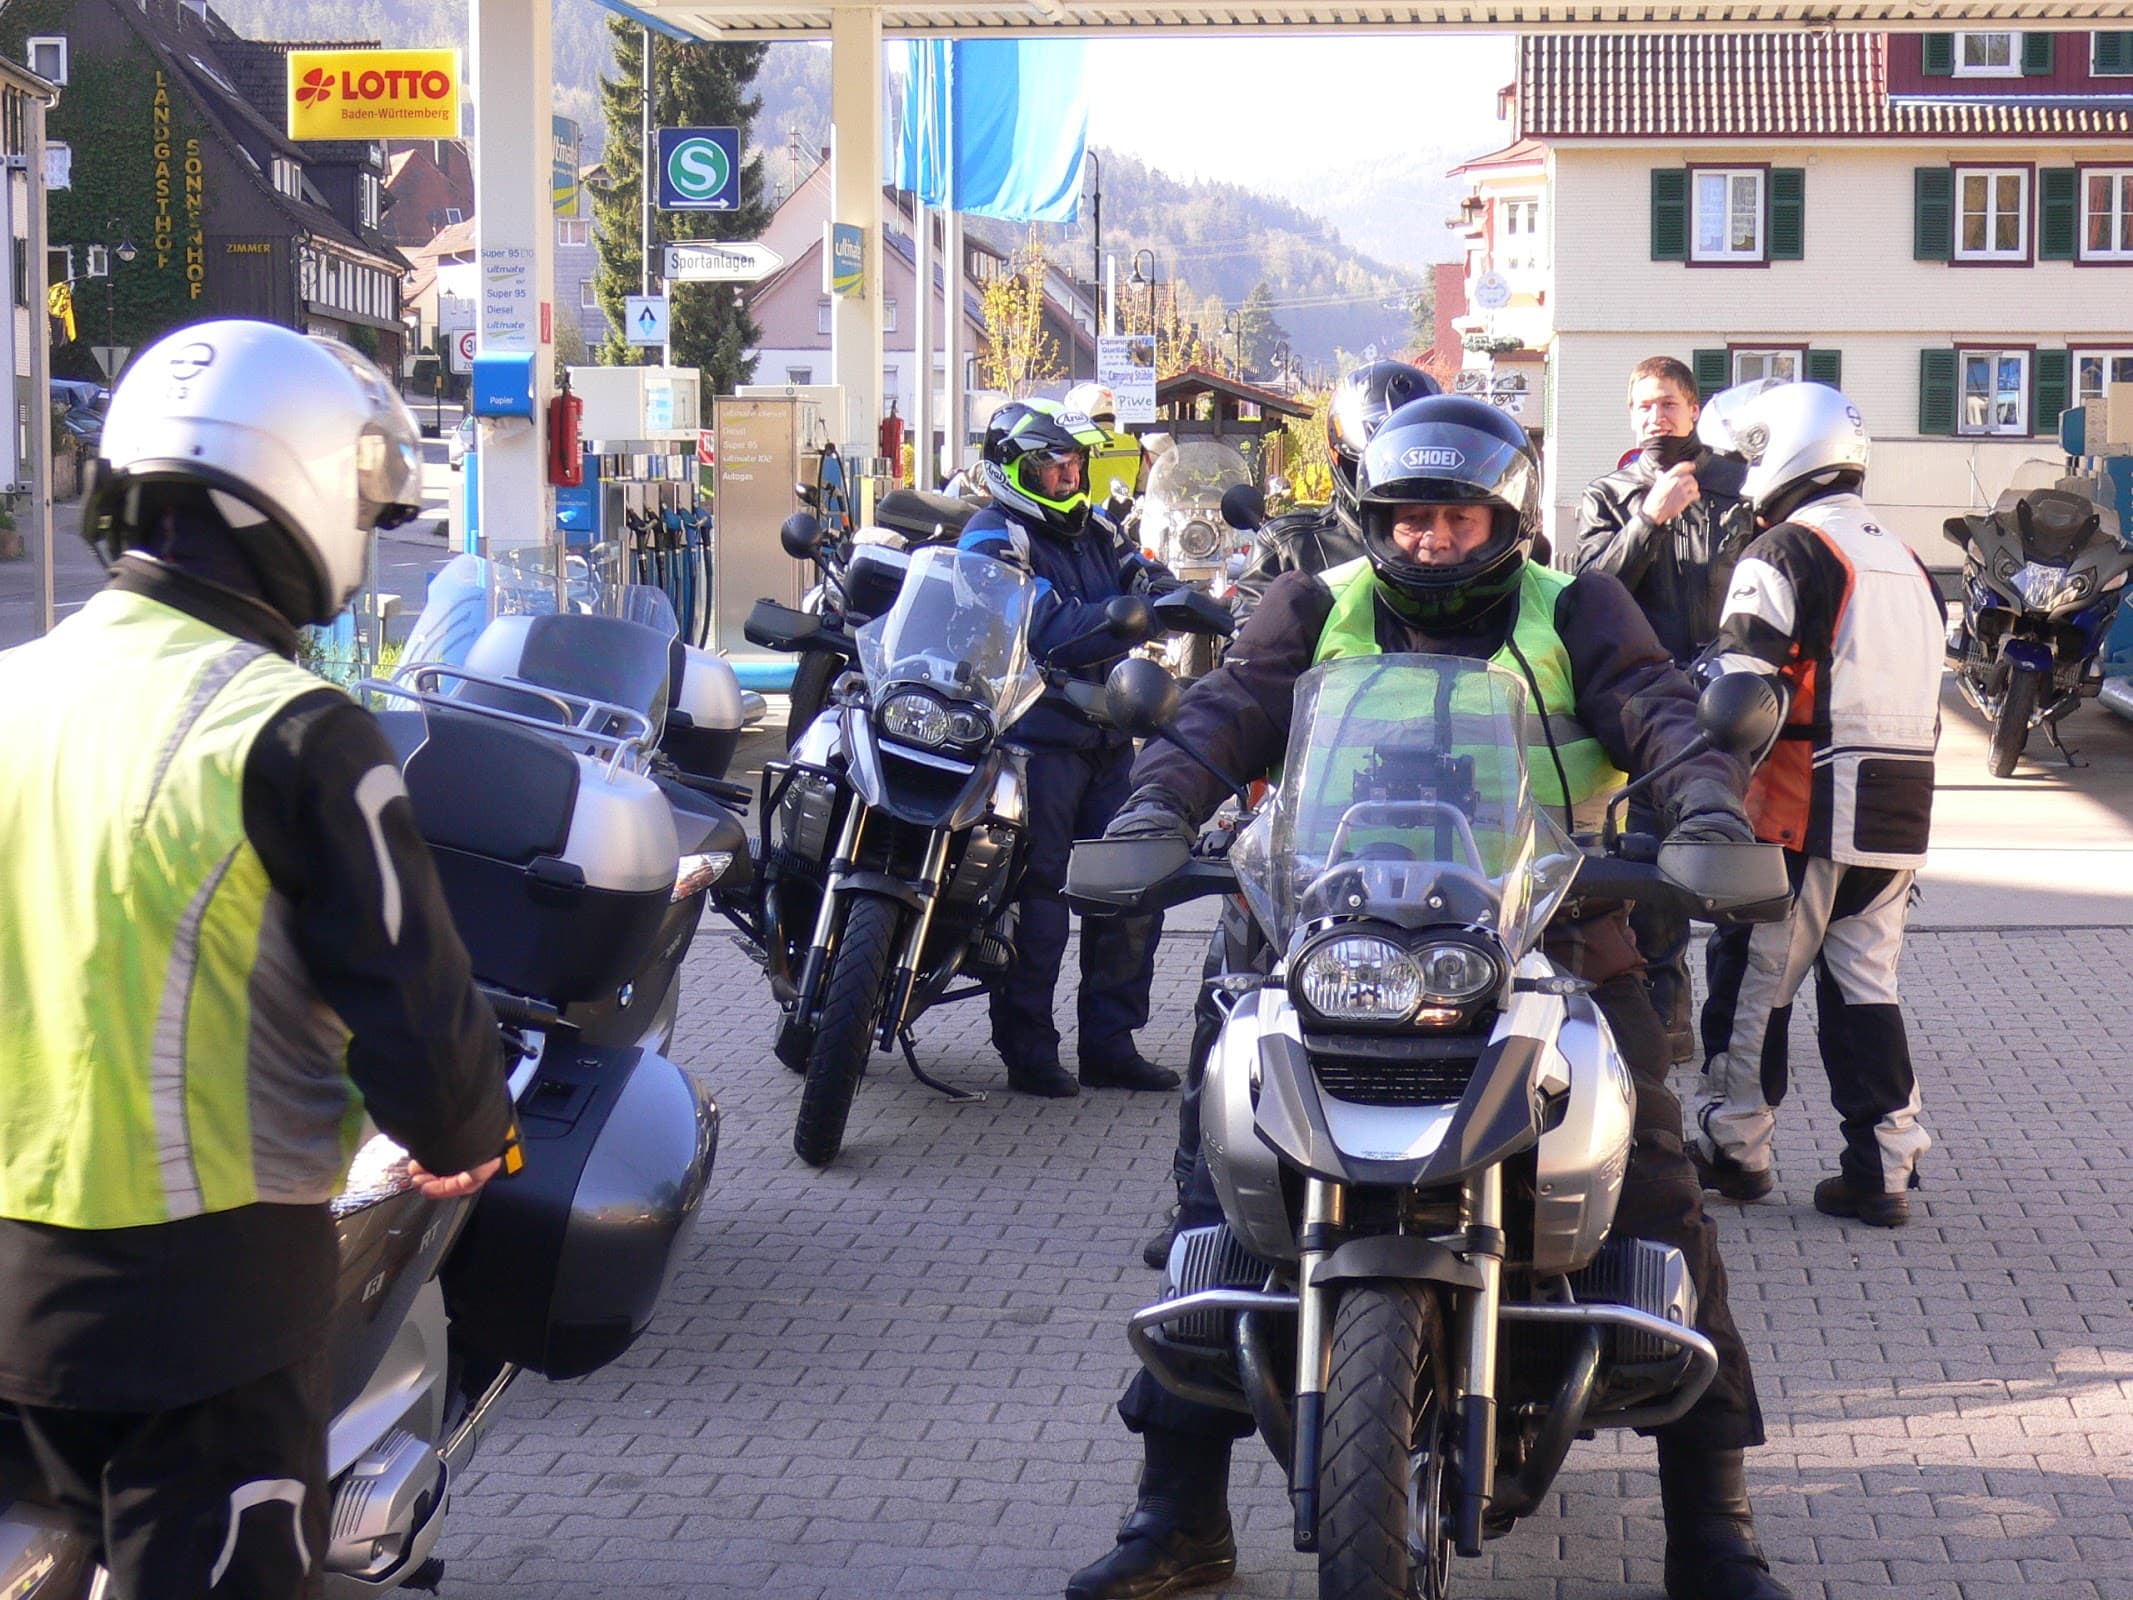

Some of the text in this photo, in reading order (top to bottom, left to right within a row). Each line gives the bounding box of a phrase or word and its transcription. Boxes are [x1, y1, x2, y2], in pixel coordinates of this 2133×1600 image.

[342, 70, 450, 100] LOTTO
[341, 108, 449, 121] Baden-Württemberg
[154, 70, 172, 269] LANDGASTHOF
[680, 145, 717, 192] S
[226, 243, 271, 253] ZIMMER
[481, 249, 505, 259] Super
[508, 249, 520, 257] 95
[671, 253, 755, 272] Sportanlagen
[487, 265, 525, 274] ultimate
[487, 289, 526, 299] Super 95
[487, 305, 513, 314] Diesel
[487, 321, 525, 329] ultimate
[465, 339, 476, 353] 3
[489, 396, 514, 405] Papier
[1408, 450, 1457, 466] SHOEI
[723, 472, 753, 482] Autogas
